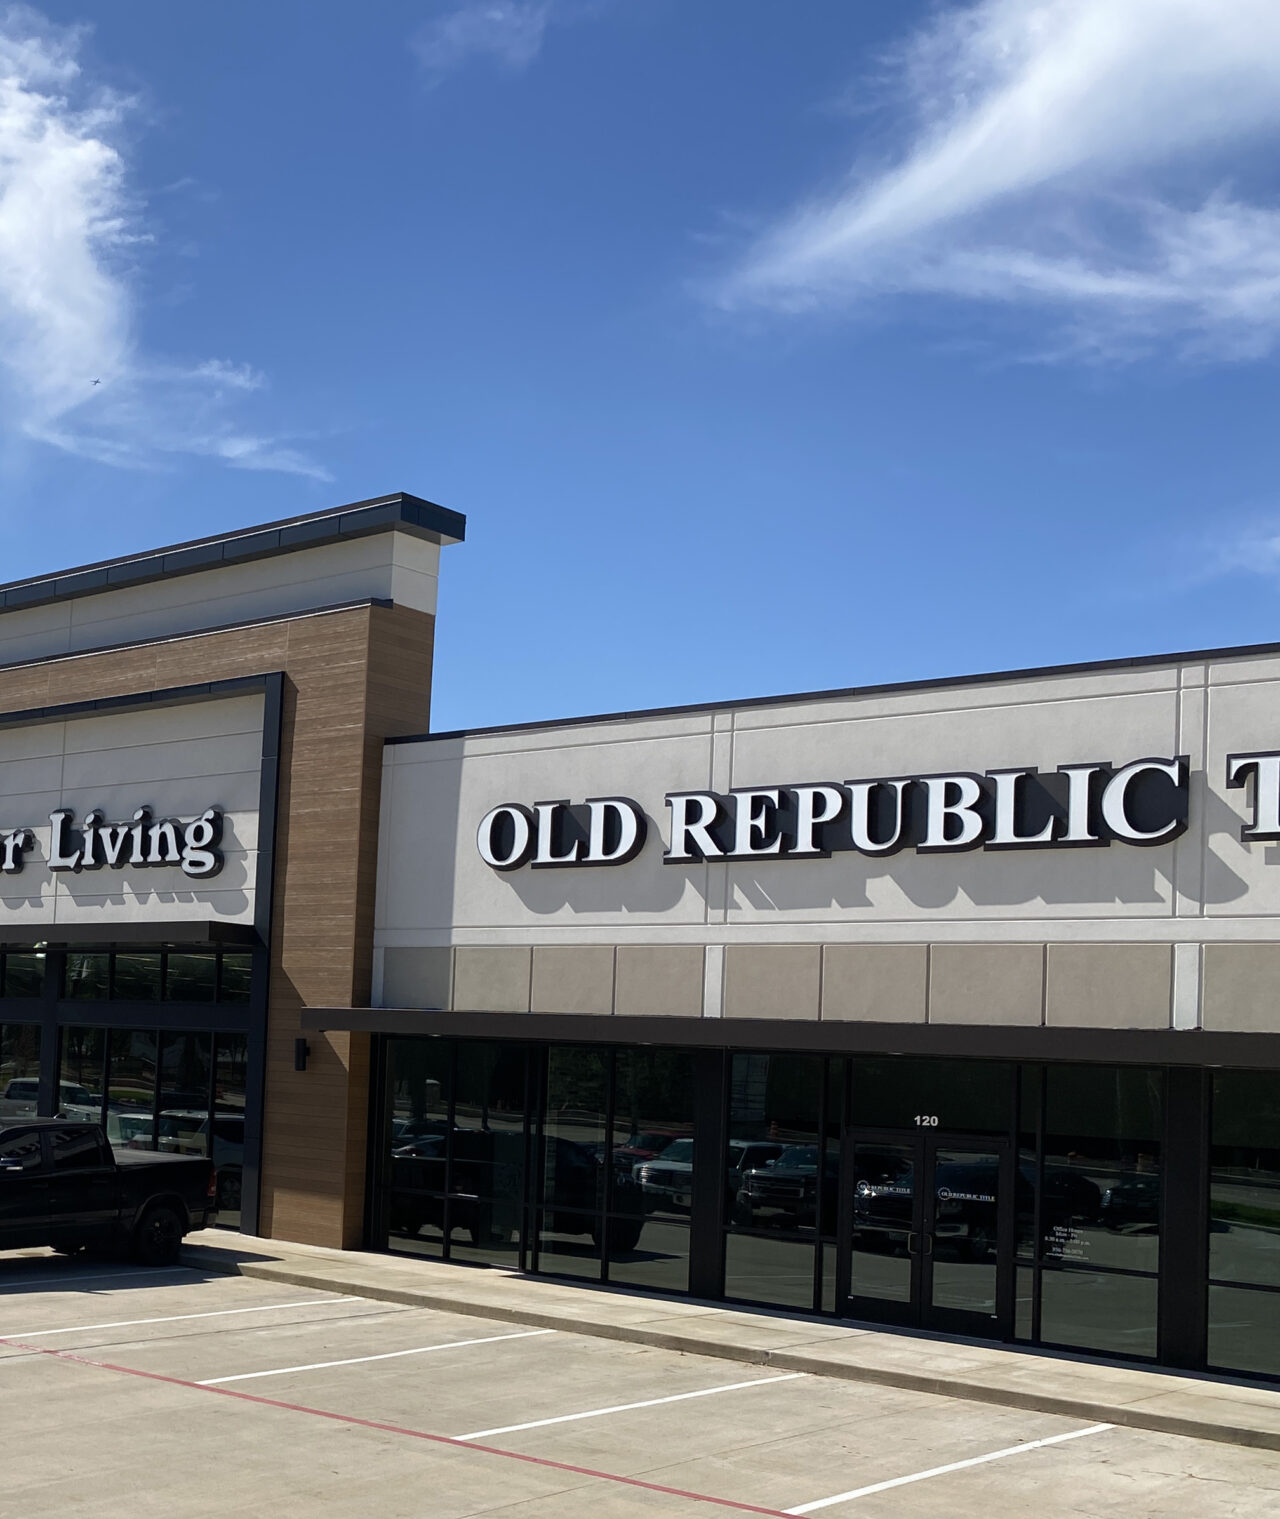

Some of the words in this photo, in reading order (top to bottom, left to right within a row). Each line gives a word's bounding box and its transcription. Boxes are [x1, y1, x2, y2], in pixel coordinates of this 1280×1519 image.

[477, 803, 639, 867] OLD
[665, 757, 1181, 858] REPUBLIC
[47, 806, 215, 875] Living
[914, 1115, 939, 1126] 120
[896, 1186, 911, 1194] TITLE
